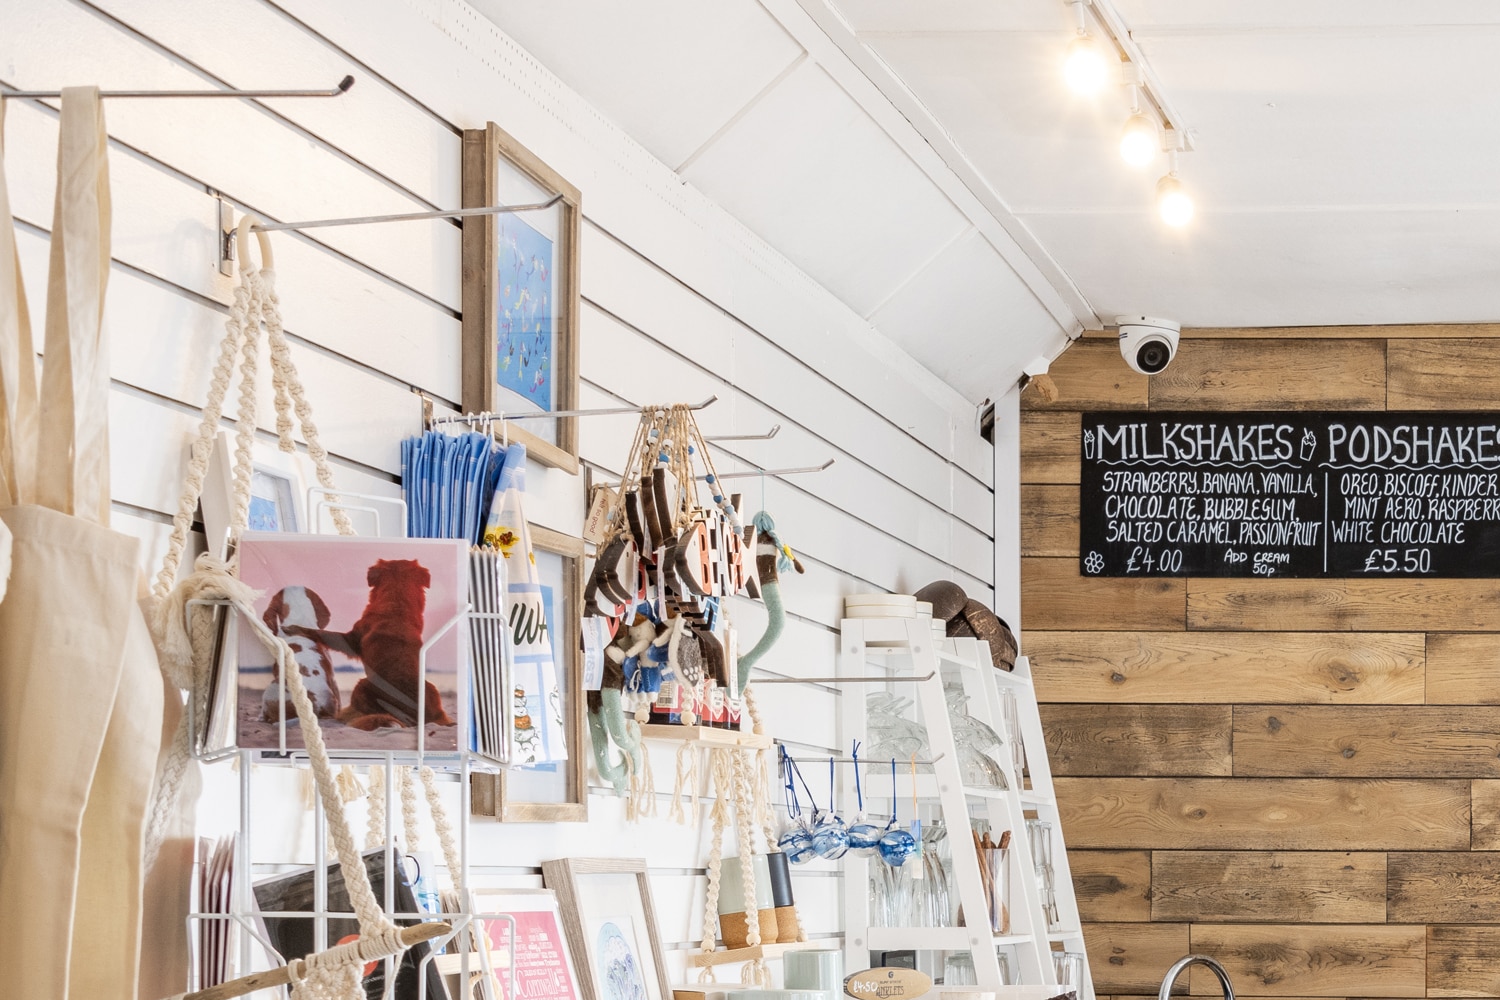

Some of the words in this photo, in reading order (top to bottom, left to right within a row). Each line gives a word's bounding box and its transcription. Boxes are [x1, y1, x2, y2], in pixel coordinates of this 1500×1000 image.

[1097, 424, 1294, 462] MILKSHAKES
[1345, 498, 1382, 519] MINT
[1106, 521, 1163, 544] SALTED
[1239, 521, 1321, 547] PASSIONFRUIT
[1332, 523, 1374, 544] WHITE
[1381, 523, 1466, 544] CHOCOLATE
[1126, 549, 1183, 573] £4.00
[1224, 549, 1248, 564] ADD
[1253, 552, 1290, 564] CREAM
[1364, 549, 1431, 573] £5.50
